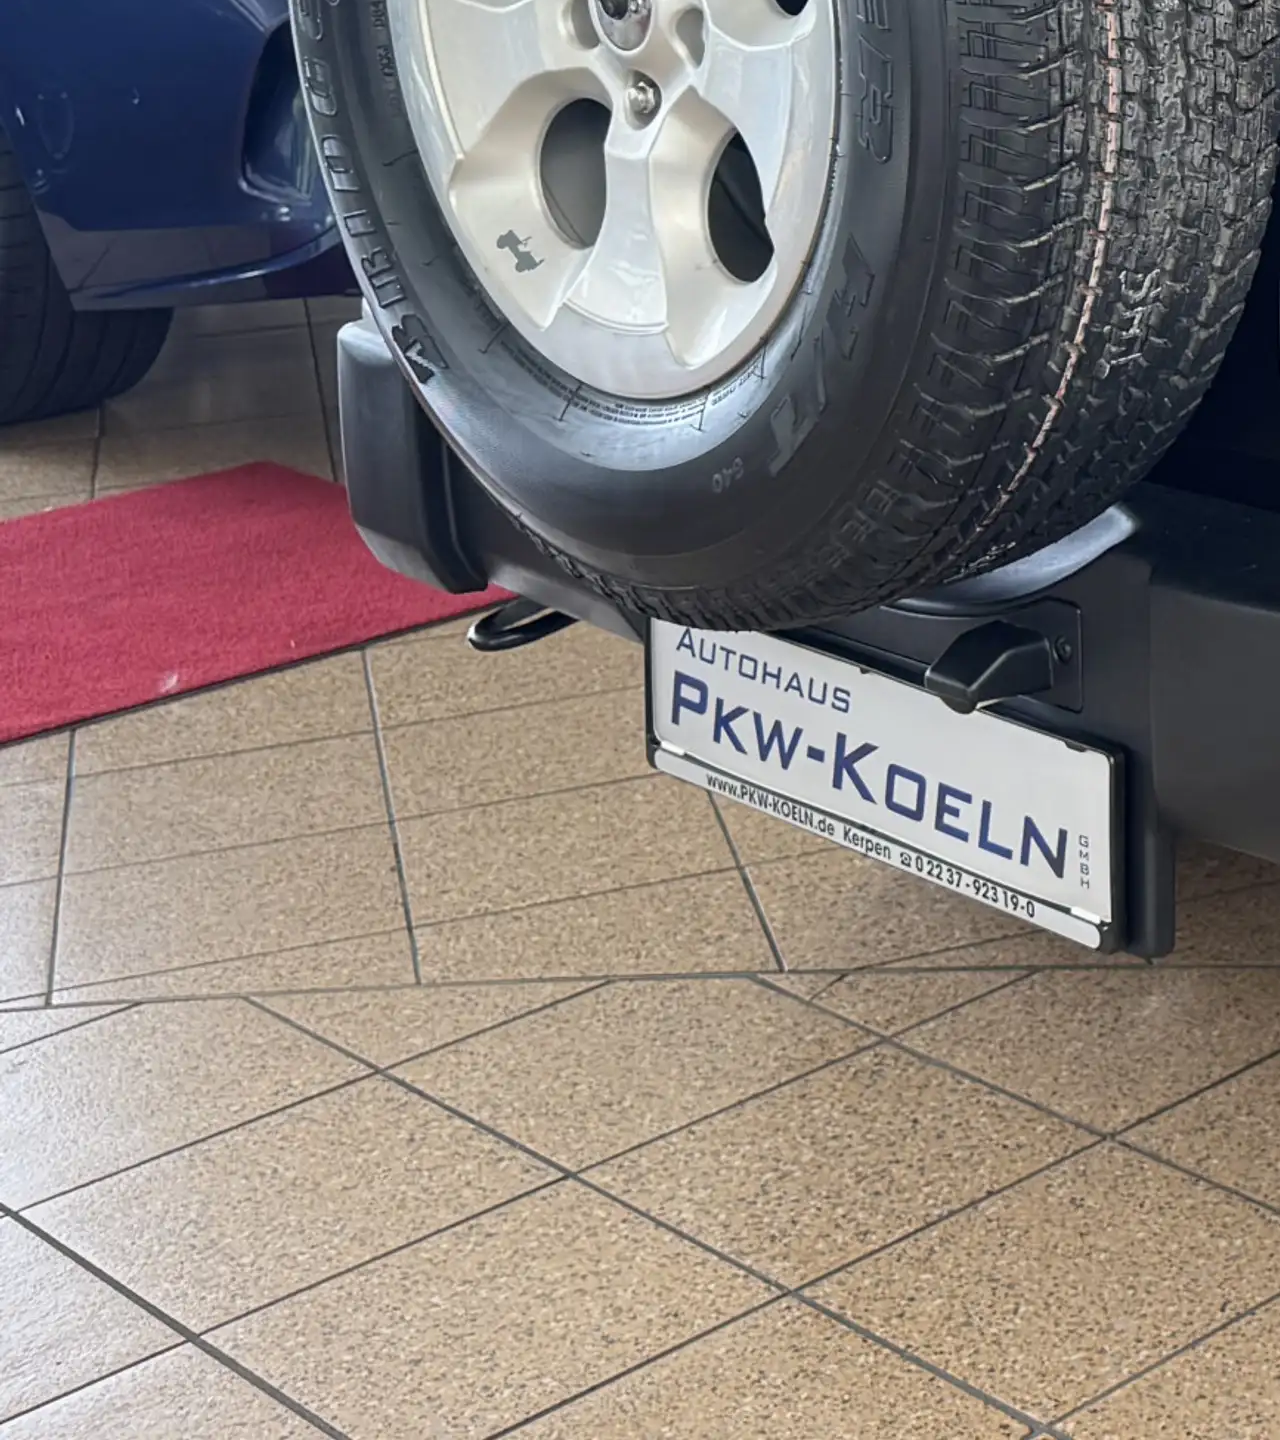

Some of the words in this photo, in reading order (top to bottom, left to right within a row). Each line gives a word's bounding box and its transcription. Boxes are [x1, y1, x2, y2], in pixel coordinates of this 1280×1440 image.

[676, 628, 851, 713] AUTOHAUS
[671, 671, 1068, 879] PKW-KOELN
[706, 774, 834, 836] www.PKW-KOELN.de
[843, 825, 891, 859] Kerpen
